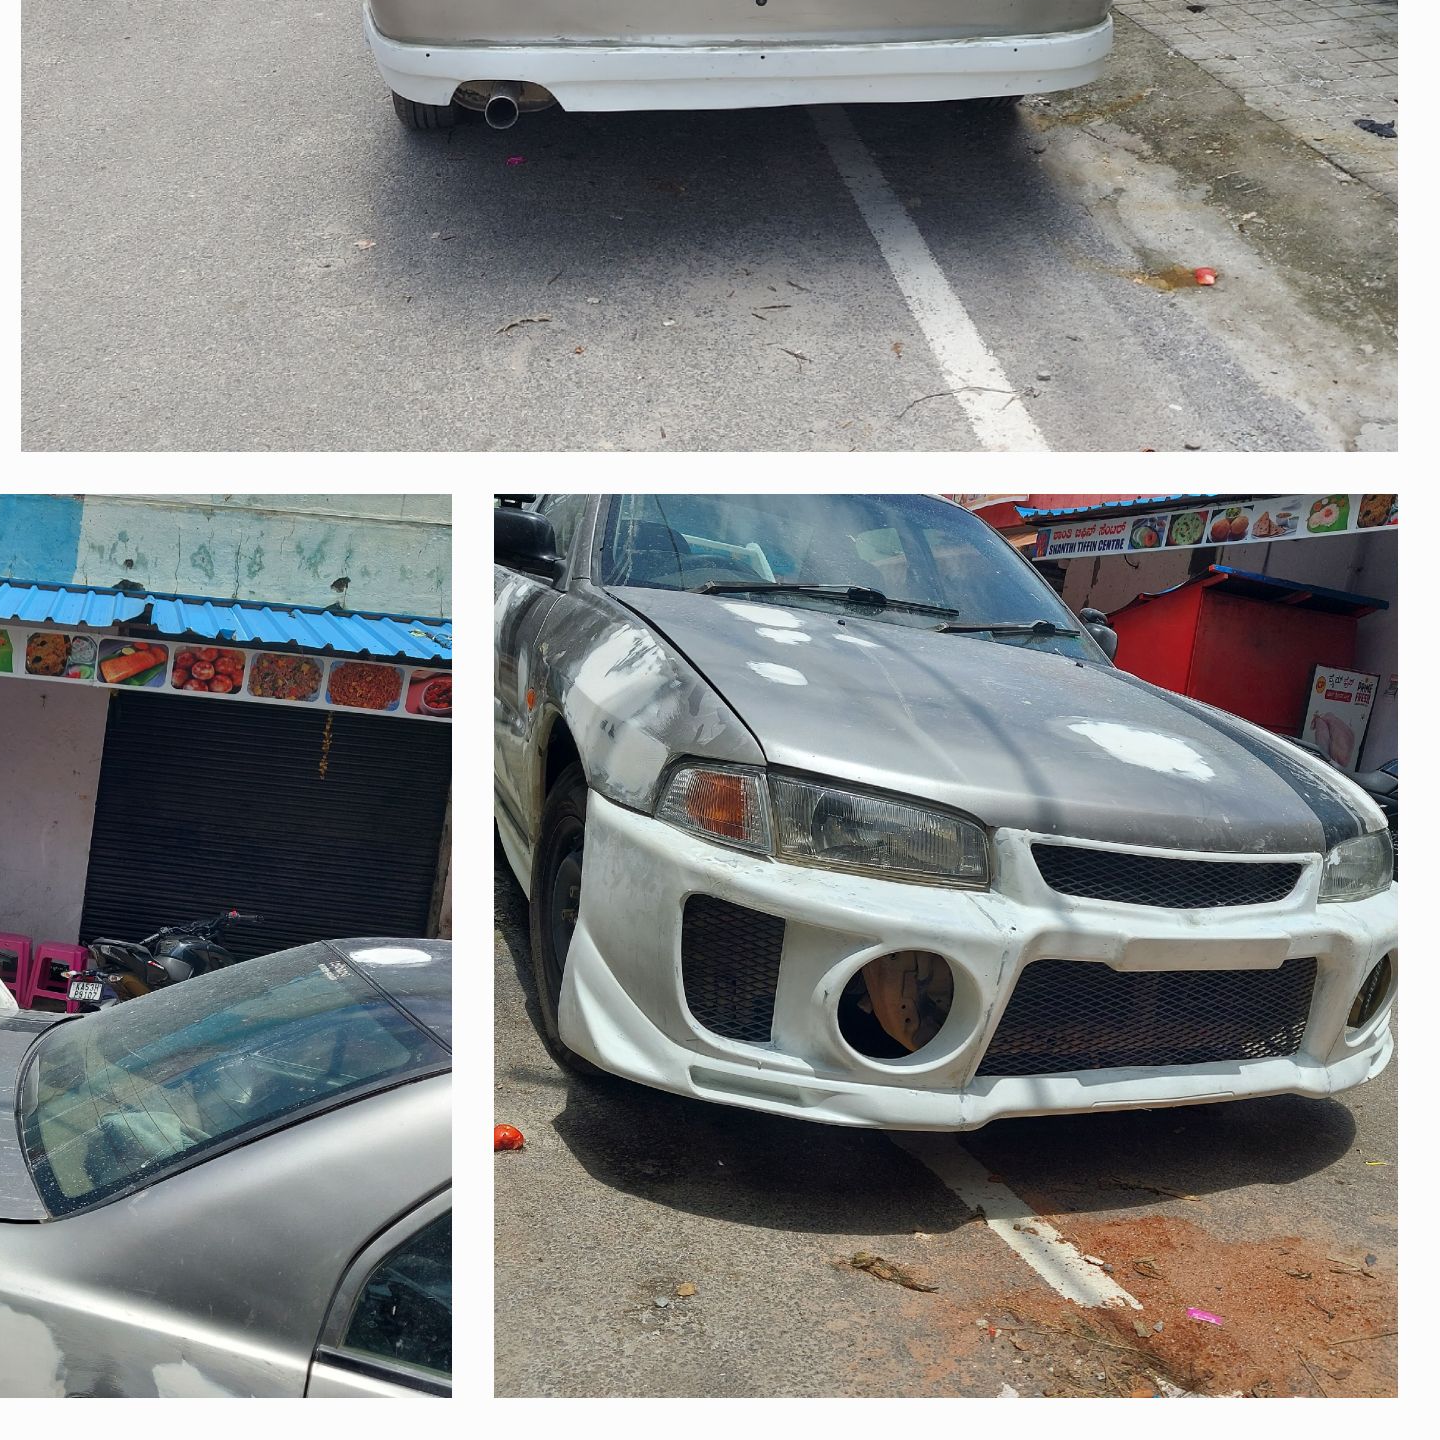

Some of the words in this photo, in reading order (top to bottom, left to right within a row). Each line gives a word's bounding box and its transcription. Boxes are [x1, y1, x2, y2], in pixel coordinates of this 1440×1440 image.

[1048, 542, 1076, 555] SHANTHI
[1077, 540, 1098, 553] TIFFIN
[1097, 538, 1125, 551] CENTRE
